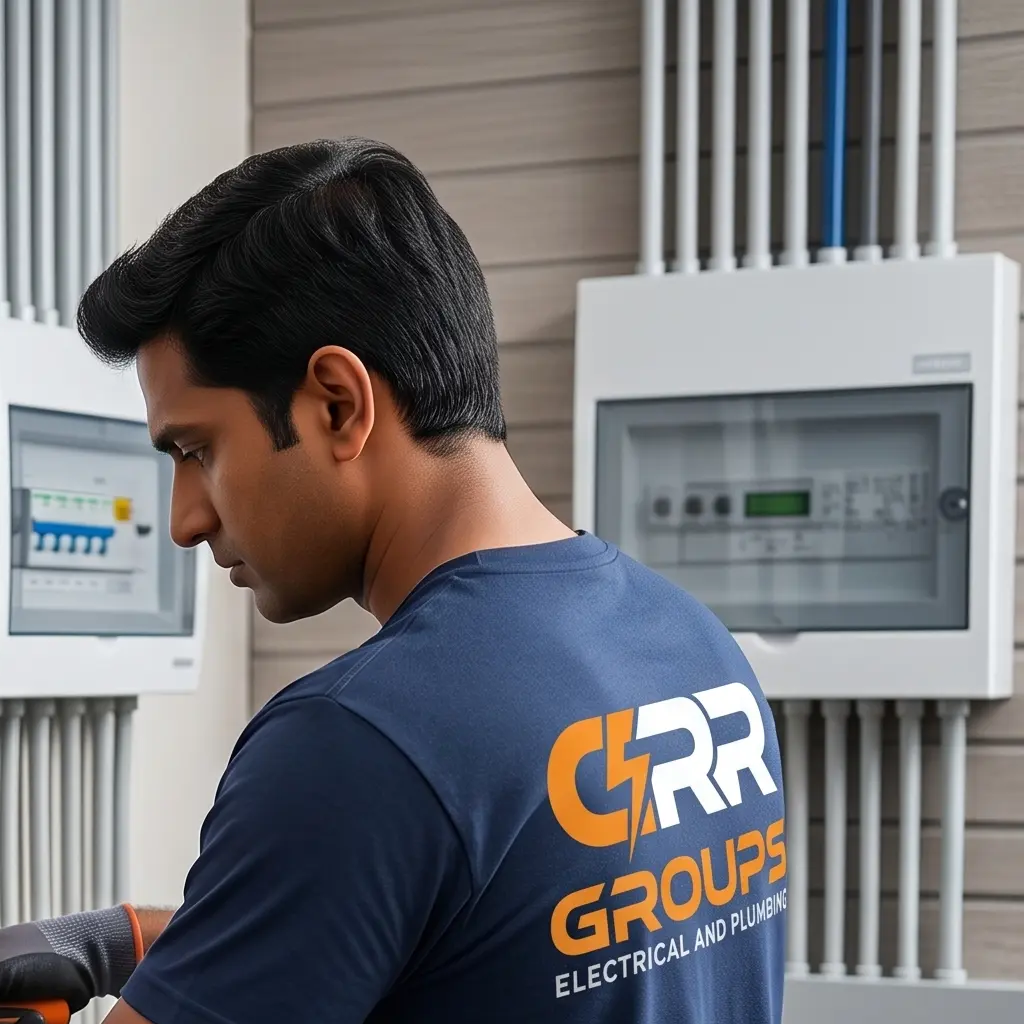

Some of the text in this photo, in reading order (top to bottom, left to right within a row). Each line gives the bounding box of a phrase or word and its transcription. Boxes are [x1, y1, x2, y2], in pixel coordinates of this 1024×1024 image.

[547, 682, 778, 864] CRR
[550, 818, 787, 956] GROUPS
[555, 887, 788, 999] ELECTRICAL AND PLUMBING
